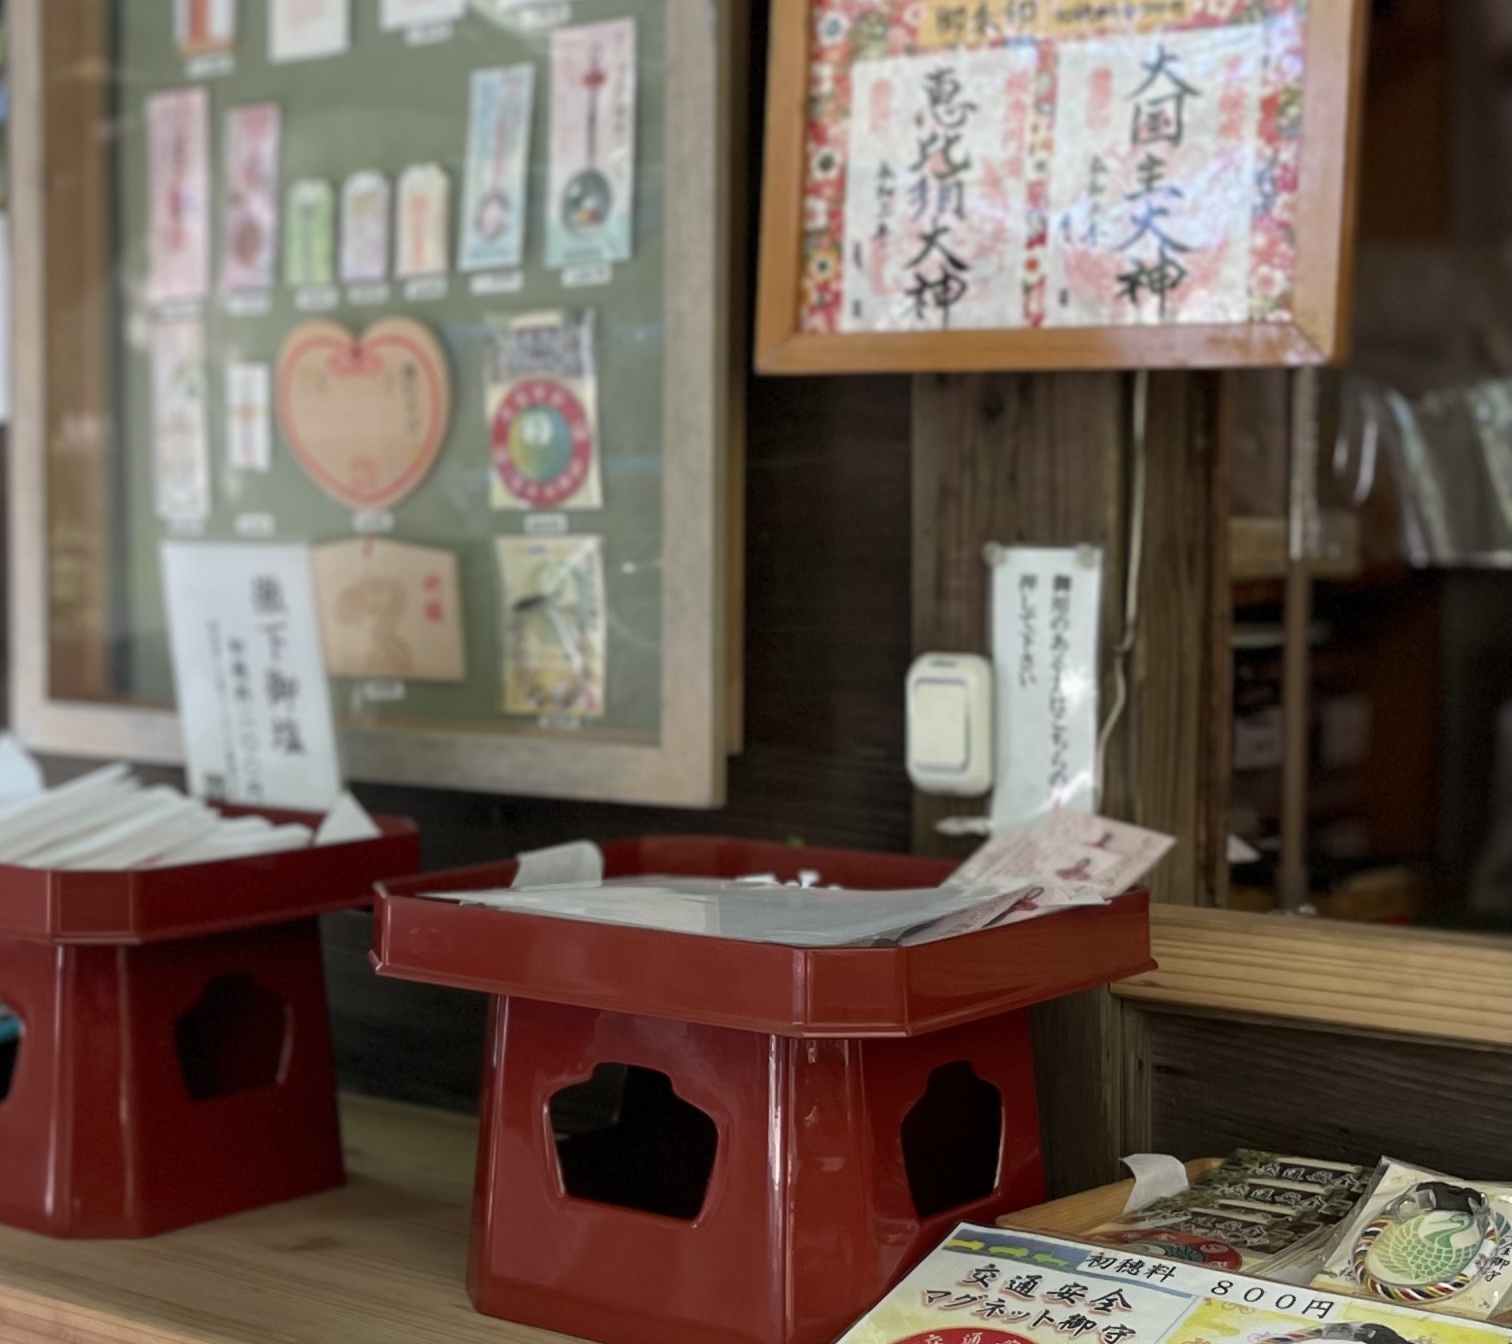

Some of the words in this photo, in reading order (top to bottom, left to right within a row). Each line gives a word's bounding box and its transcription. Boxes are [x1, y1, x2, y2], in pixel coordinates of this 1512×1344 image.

[960, 1262, 1134, 1316] 交通安全
[1086, 1250, 1177, 1285] 初穂料
